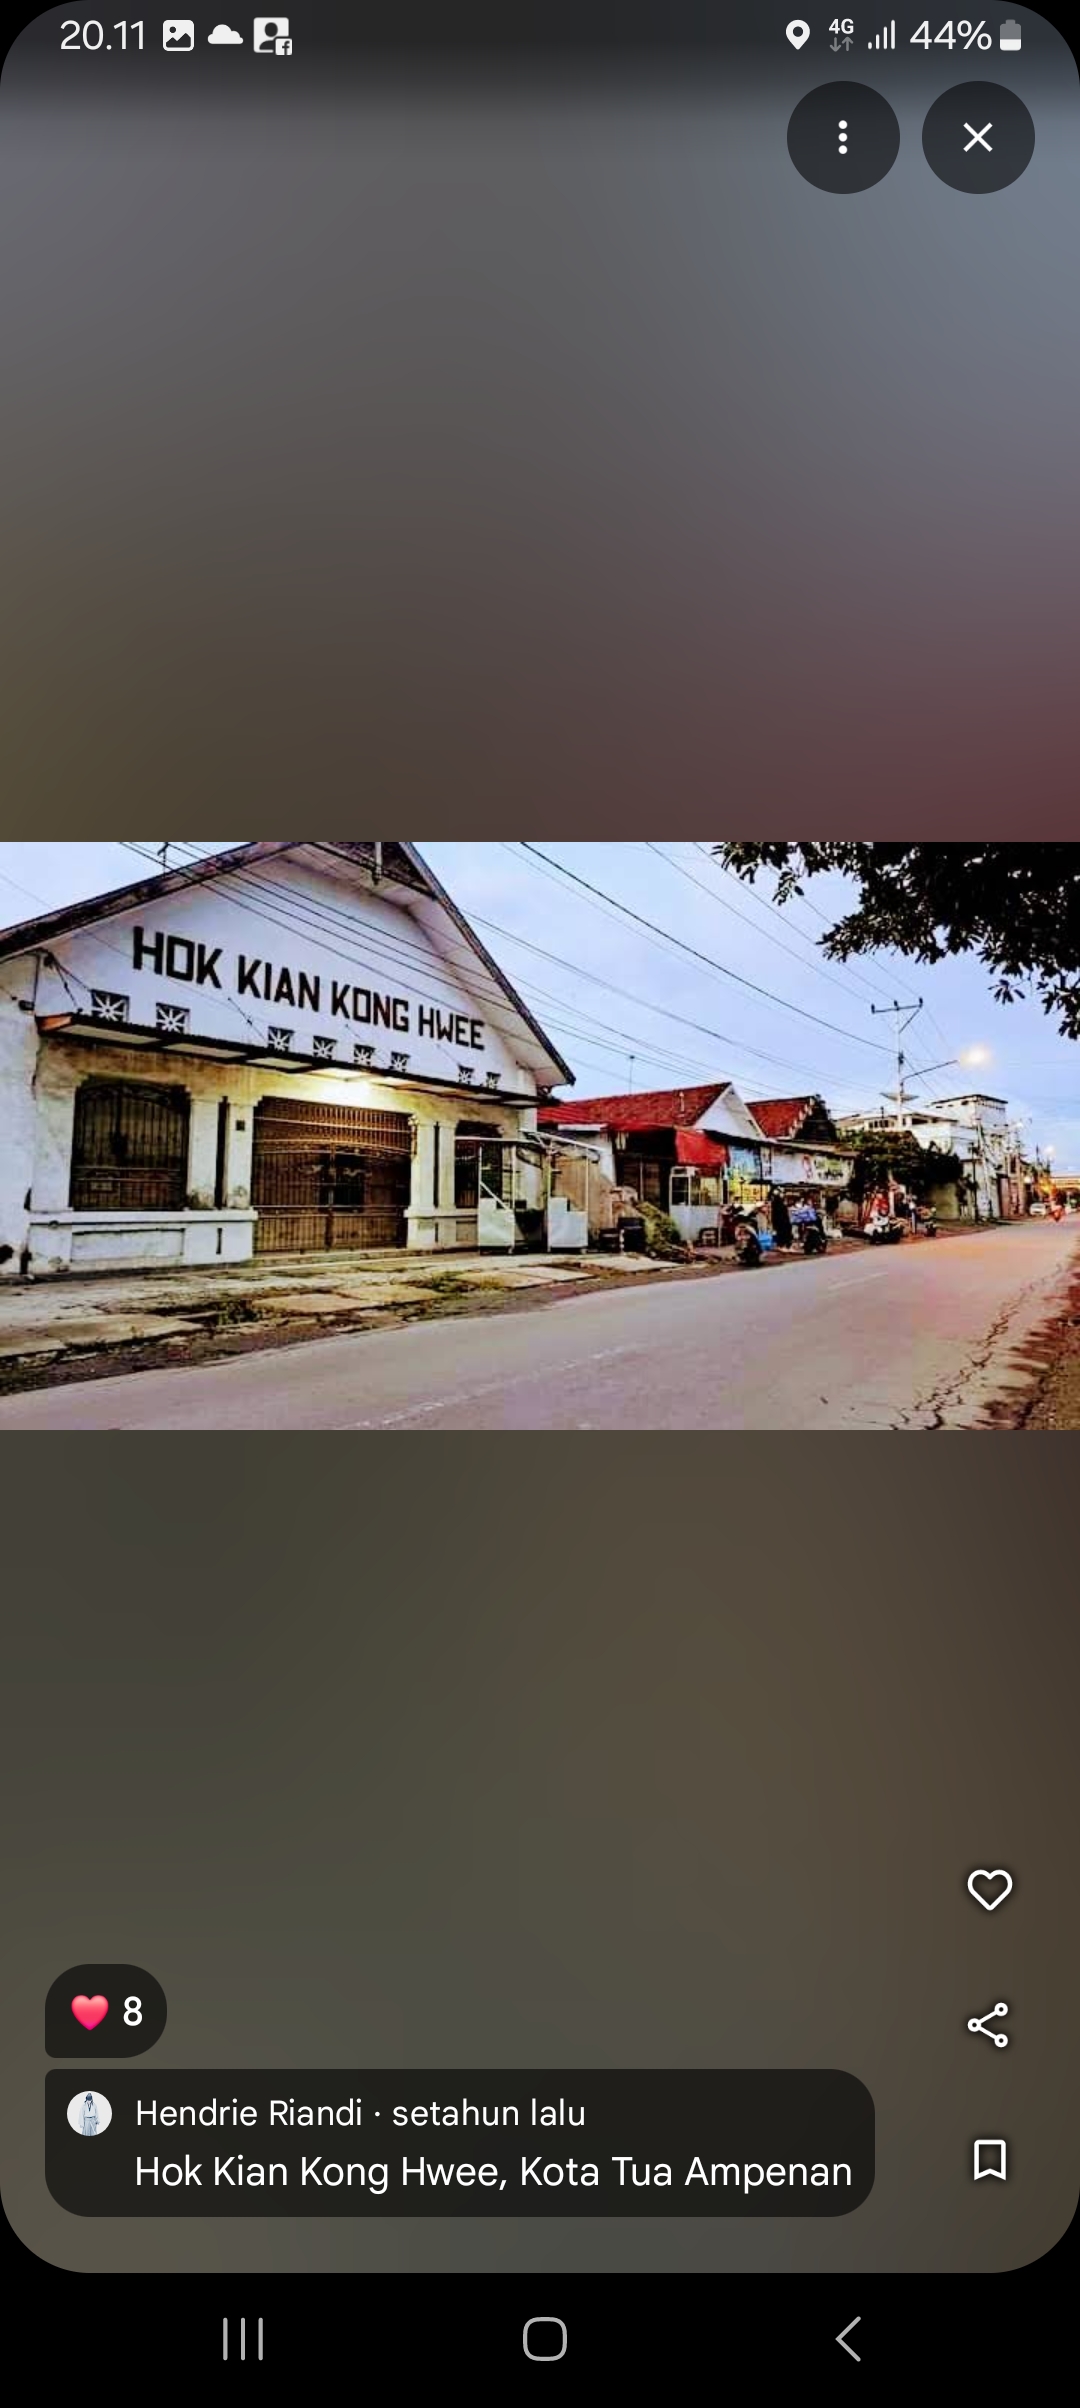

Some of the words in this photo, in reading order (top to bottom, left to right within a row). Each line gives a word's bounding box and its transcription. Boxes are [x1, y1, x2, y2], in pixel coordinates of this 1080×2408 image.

[132, 925, 223, 990] HOK
[237, 953, 321, 1013] KIAN
[331, 979, 410, 1034] KONG
[418, 1004, 485, 1051] HWEE
